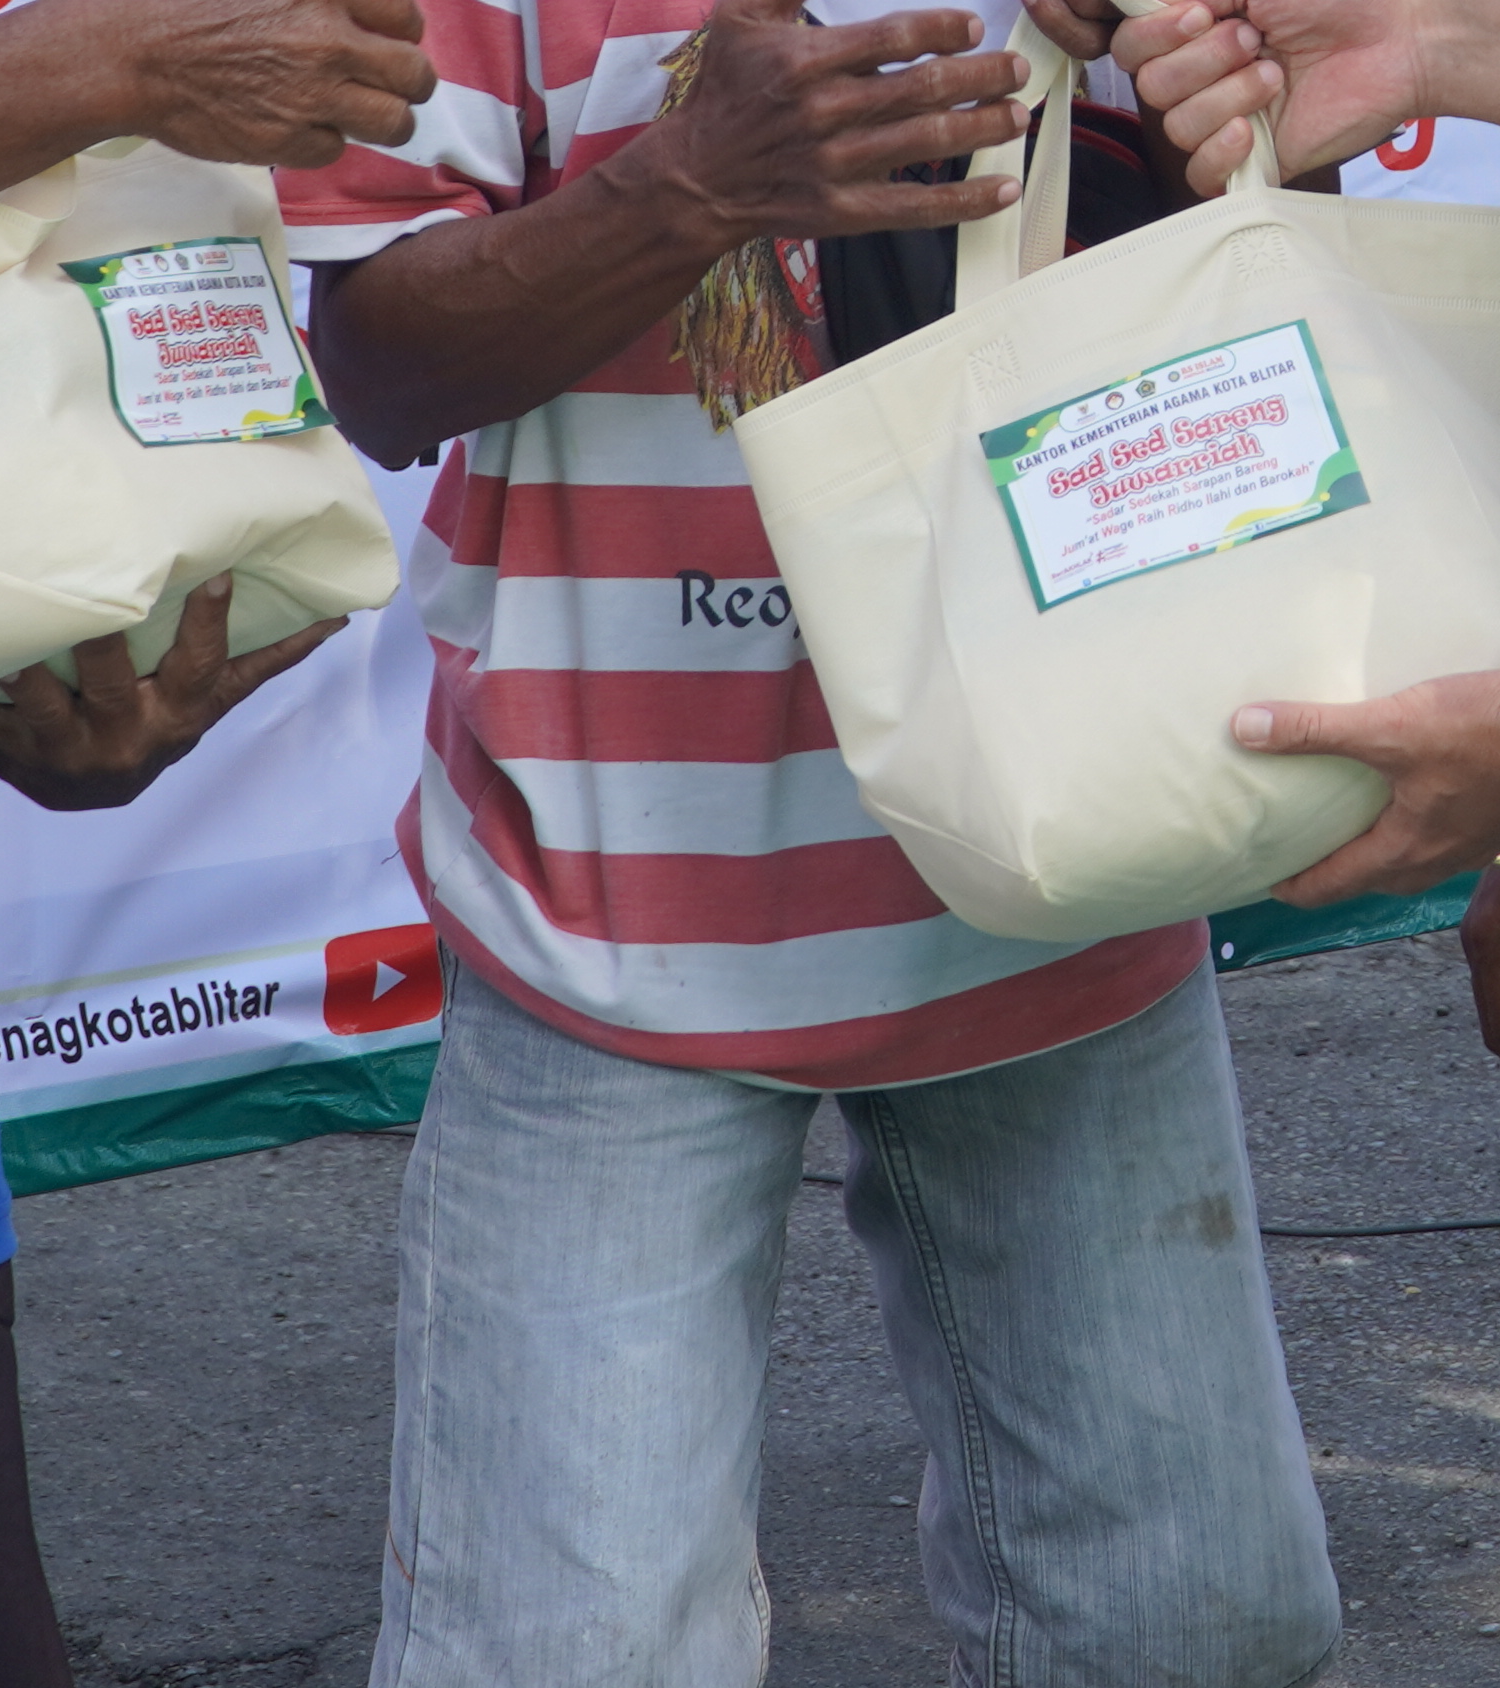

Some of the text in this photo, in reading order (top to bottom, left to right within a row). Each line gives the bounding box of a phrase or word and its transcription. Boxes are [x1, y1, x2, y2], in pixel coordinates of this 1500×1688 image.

[1016, 443, 1068, 472] KANTOR
[1070, 403, 1160, 451] KEMENTERIAN
[1163, 387, 1211, 412] AGAMA
[1213, 376, 1248, 396] KOTA
[1250, 359, 1297, 384] BLITAR
[1048, 394, 1289, 498] Sad Sed Sareng
[1090, 431, 1265, 509] Juwarriah
[1128, 485, 1181, 511] Sedekah
[1183, 470, 1233, 494] Sarapan
[1235, 456, 1279, 477] Bareng
[1101, 518, 1135, 538] Wage
[1137, 505, 1165, 525] Raih
[1167, 496, 1204, 516] Ridho
[1234, 479, 1257, 497] dan
[674, 568, 801, 639] Reo
